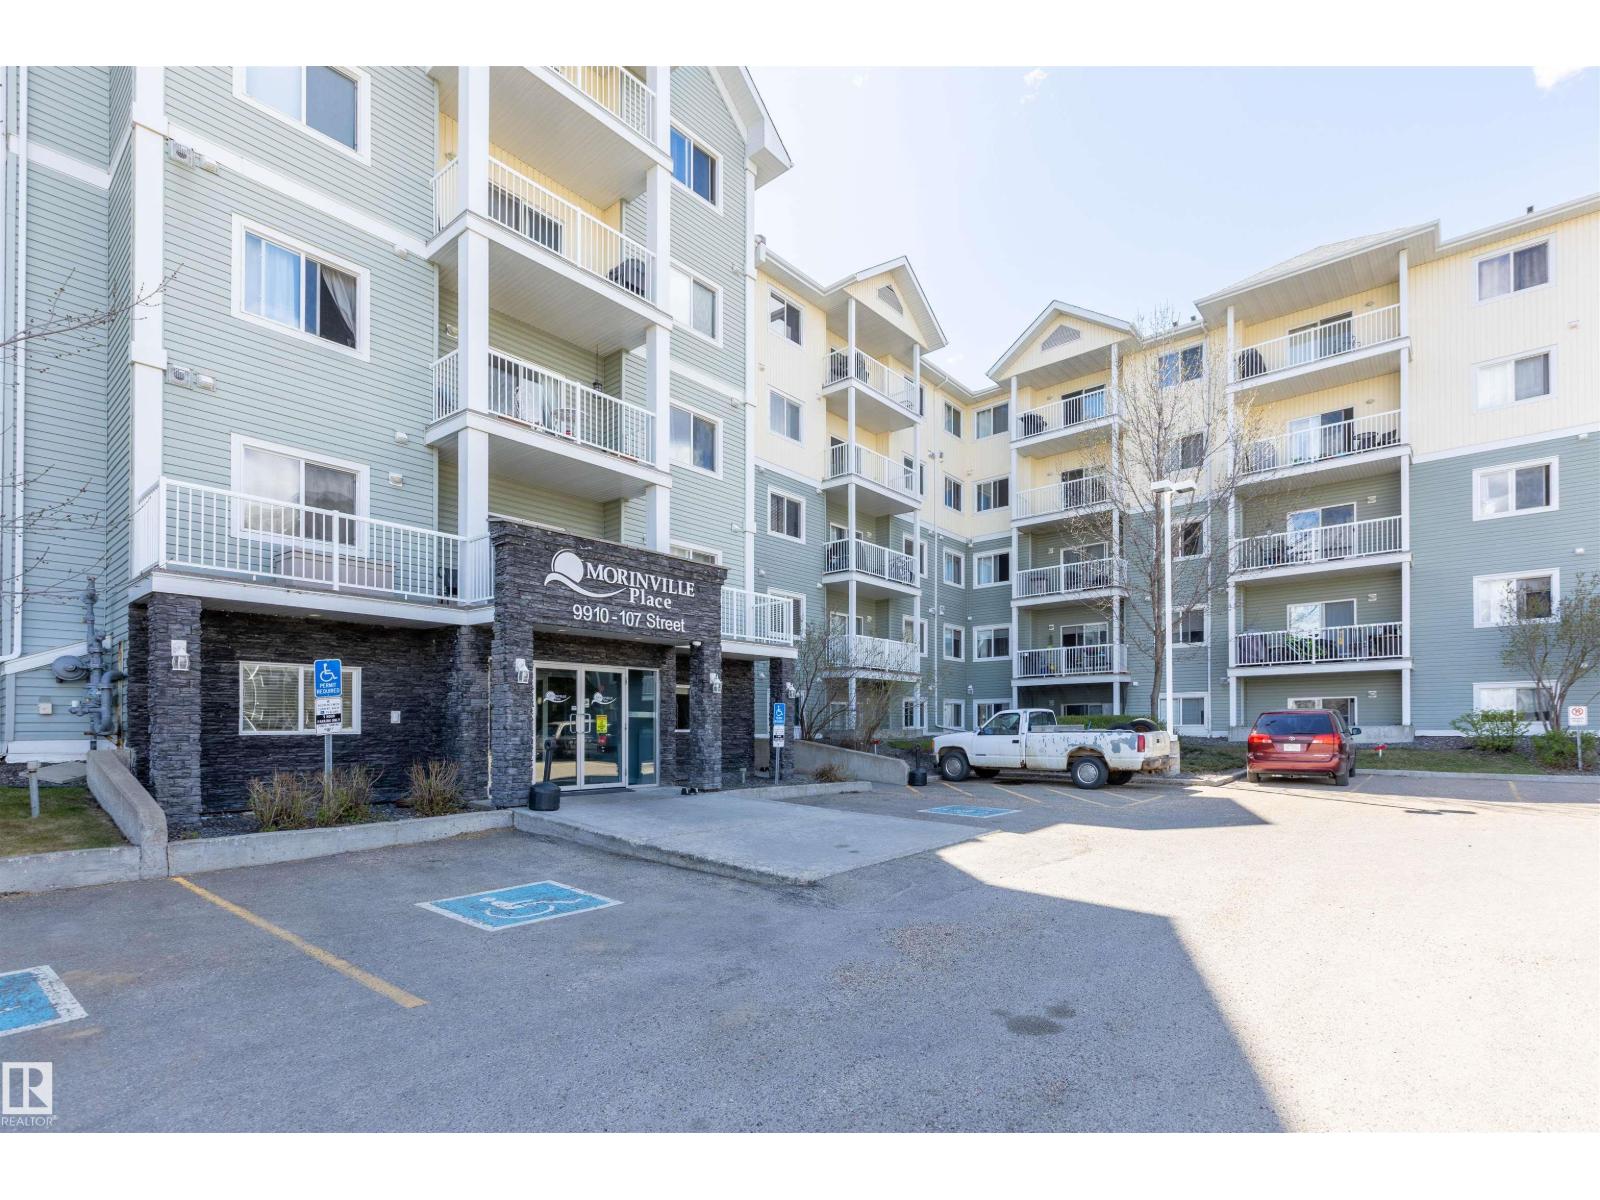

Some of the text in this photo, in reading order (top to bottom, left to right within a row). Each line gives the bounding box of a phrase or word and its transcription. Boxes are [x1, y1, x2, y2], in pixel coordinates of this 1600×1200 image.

[585, 562, 695, 597] MORINVILLE
[629, 587, 672, 609] Place
[646, 613, 686, 633] Street
